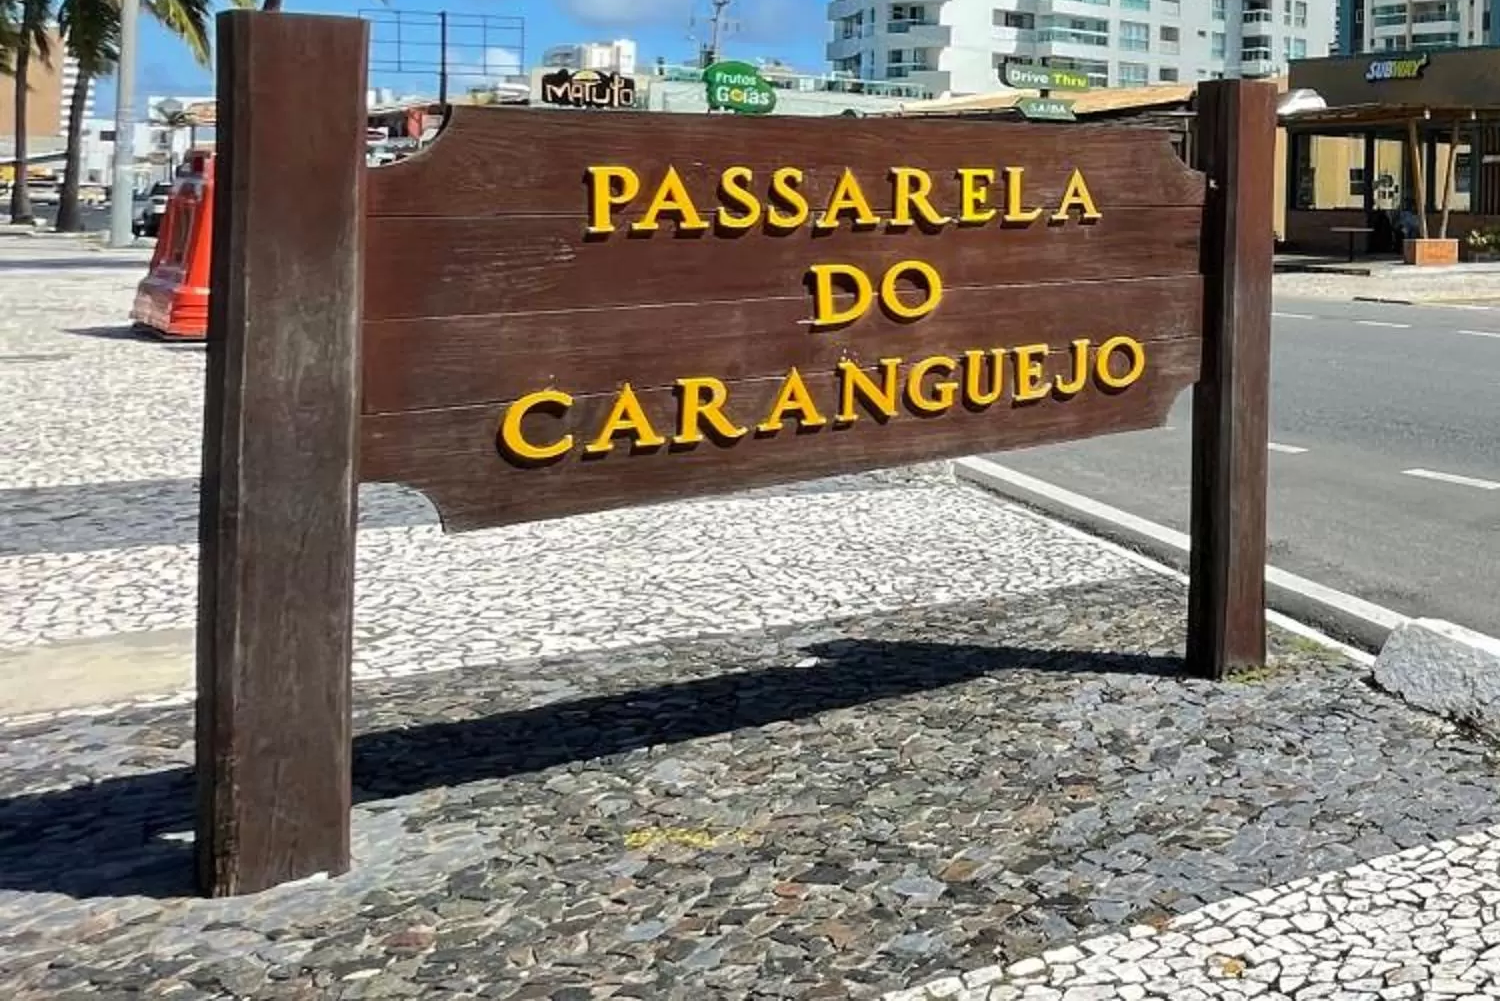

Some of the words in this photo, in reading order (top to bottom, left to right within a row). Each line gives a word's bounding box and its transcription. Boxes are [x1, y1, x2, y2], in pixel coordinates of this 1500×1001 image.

[715, 72, 757, 85] Frutos
[1011, 70, 1049, 84] Drive
[1053, 72, 1087, 87] Thru
[1366, 52, 1427, 80] SUBWAY
[584, 166, 1102, 233] PASSARELA
[808, 260, 942, 326] DO
[500, 336, 1146, 460] CARANGUEJO
